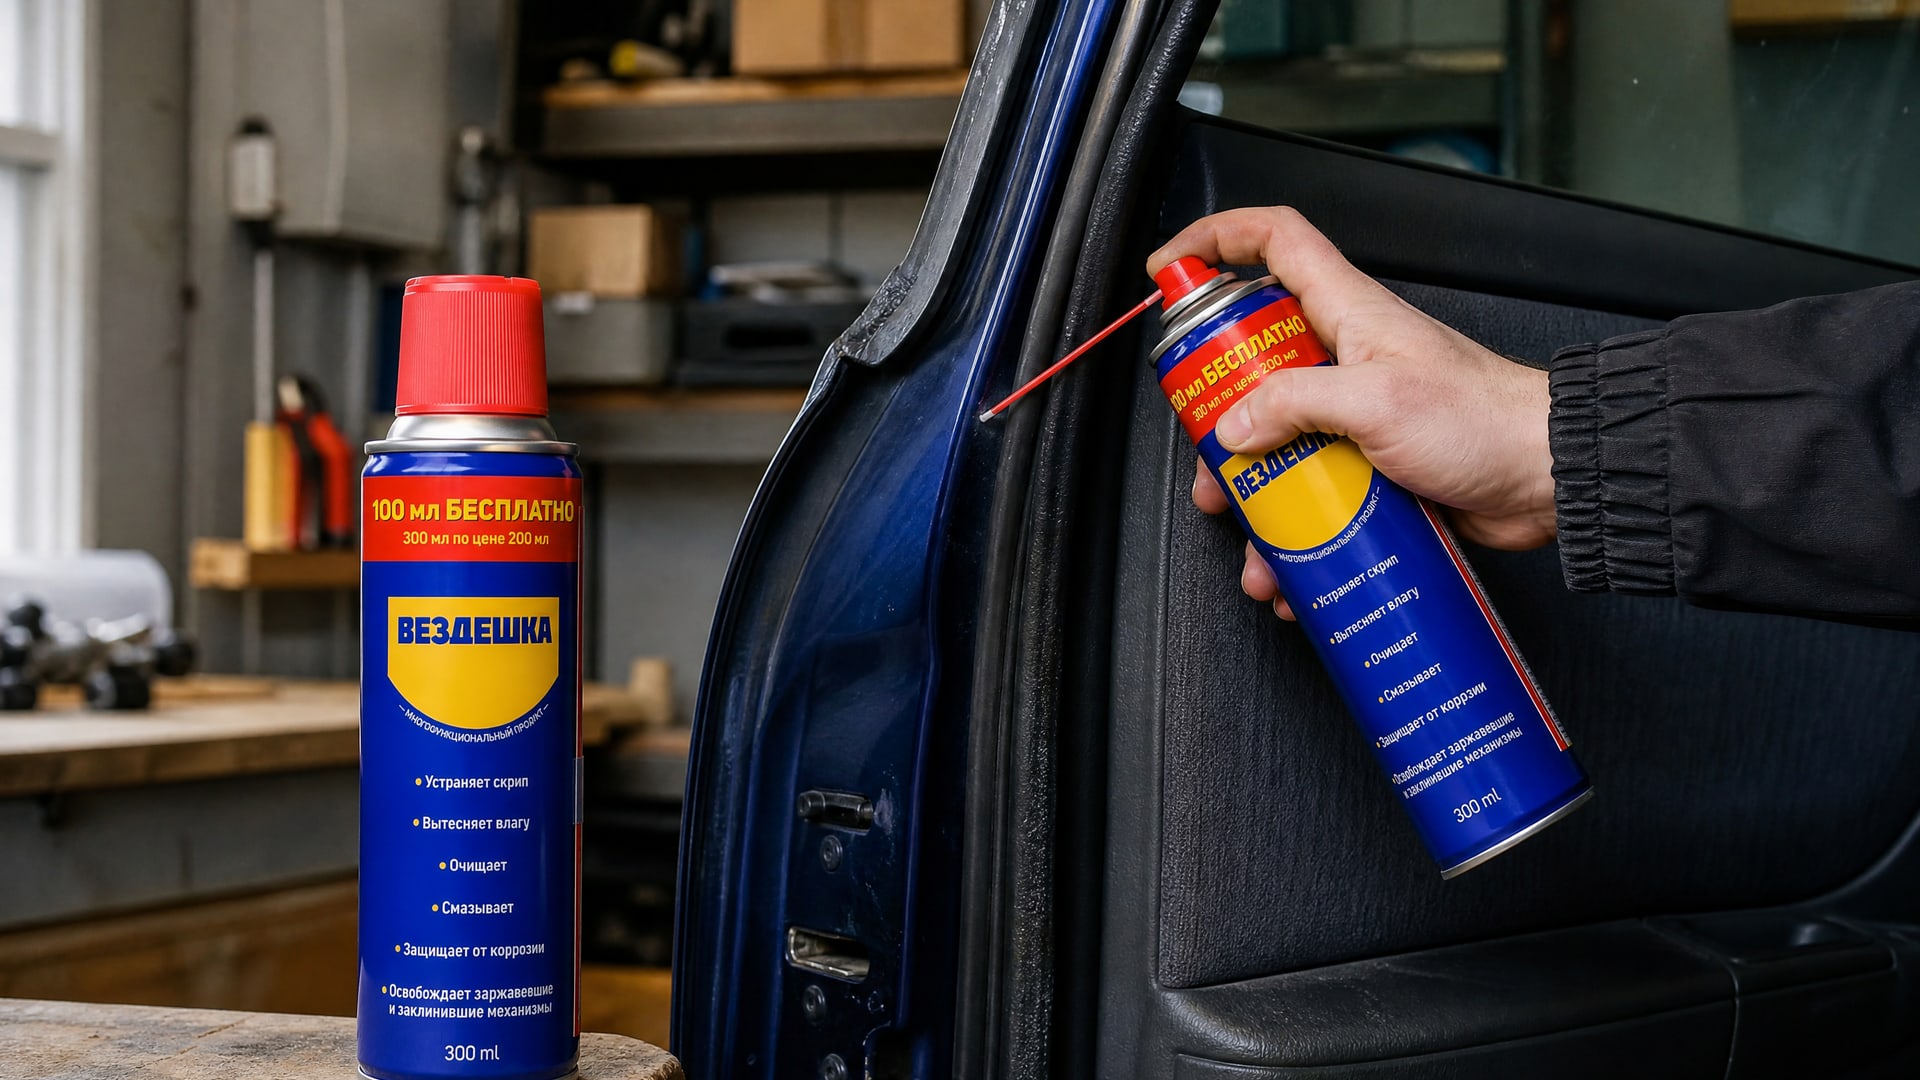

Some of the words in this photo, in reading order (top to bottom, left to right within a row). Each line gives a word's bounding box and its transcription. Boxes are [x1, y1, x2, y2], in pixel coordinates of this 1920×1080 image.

[1186, 378, 1206, 401] мл
[1202, 316, 1306, 386] БЕСПЛАТНО
[1193, 404, 1207, 421] 300
[1207, 397, 1221, 410] мл
[1221, 388, 1233, 400] по
[1234, 370, 1261, 392] цене
[1259, 355, 1282, 374] 200
[1283, 350, 1298, 361] мл
[373, 499, 404, 520] 100
[410, 504, 439, 520] мл
[446, 499, 573, 521] БЕСПЛАТНО
[403, 531, 428, 544] 300
[432, 535, 449, 544] мл
[453, 535, 469, 544] по
[473, 535, 505, 546] цене
[509, 532, 531, 544] 200
[535, 536, 548, 544] мл
[1317, 573, 1365, 607] Устраняет
[1367, 555, 1398, 578] скрип
[1334, 606, 1386, 643] Вытесняет
[1387, 587, 1419, 611] влагу
[398, 617, 552, 644] ВЕЗДЕШКА
[1371, 632, 1417, 664] Очищает
[1384, 663, 1441, 701] Смазывает
[1379, 716, 1424, 747] Защищает
[1426, 708, 1438, 721] от
[1394, 750, 1447, 784] Освобождает
[1448, 713, 1514, 754] заржавевшие
[1465, 727, 1522, 764] механизмы
[425, 775, 490, 791] Устраняет
[494, 778, 528, 790] скрип
[1454, 800, 1480, 822] 300
[1482, 788, 1501, 807] ml
[423, 817, 492, 829] Вытесняет
[496, 819, 529, 831] влагу
[450, 859, 507, 873] Очищает
[442, 901, 514, 914] Смазывает
[404, 943, 469, 959] Защищает
[473, 947, 487, 957] от
[491, 944, 544, 959] коррозии
[390, 984, 471, 1002] Освобождает
[474, 985, 553, 1003] заржавевшие
[390, 1004, 395, 1014] и
[398, 1006, 484, 1018] заклинившие
[488, 1002, 551, 1017] механизмы
[445, 1045, 475, 1061] 300
[481, 1045, 499, 1060] ml
